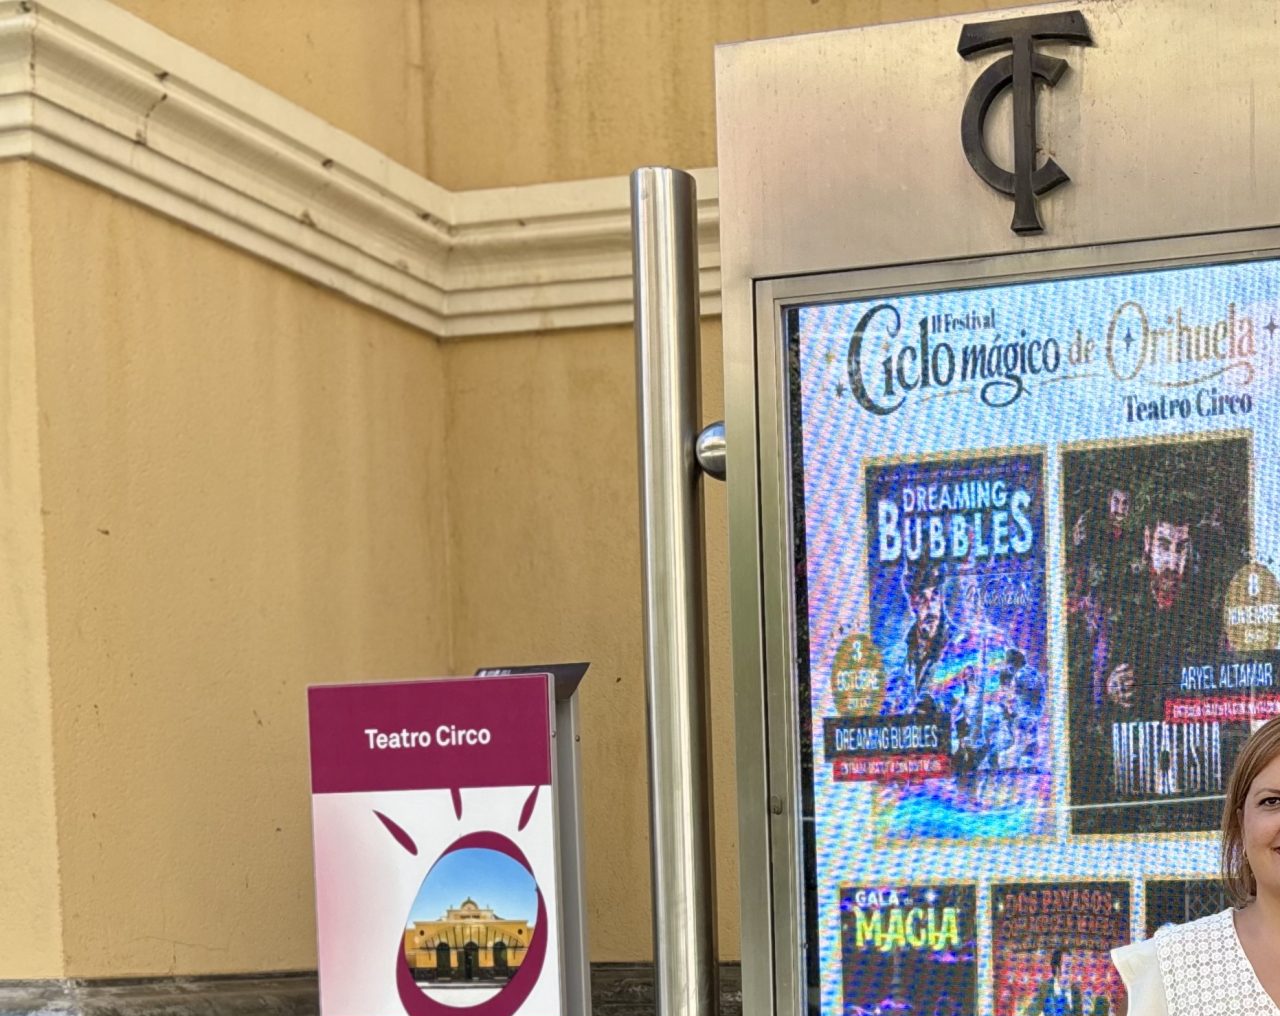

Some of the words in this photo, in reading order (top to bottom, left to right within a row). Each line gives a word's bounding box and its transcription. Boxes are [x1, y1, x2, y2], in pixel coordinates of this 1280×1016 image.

[944, 308, 995, 331] Festival
[1069, 329, 1095, 364] de
[1107, 301, 1257, 381] Orihuela
[1123, 393, 1190, 423] Teatro
[1195, 388, 1252, 417] Circo
[903, 480, 1007, 512] DREAMING
[878, 490, 1033, 561] BUBBLES
[1181, 666, 1217, 690] ARYEL
[1219, 662, 1273, 687] ALTAMAR
[365, 728, 431, 750] Teatro
[436, 725, 491, 747] Circo
[836, 727, 889, 751] DREAMING
[890, 724, 938, 749] BUBBLES
[855, 890, 899, 908] GALA
[854, 906, 960, 952] MAGIA
